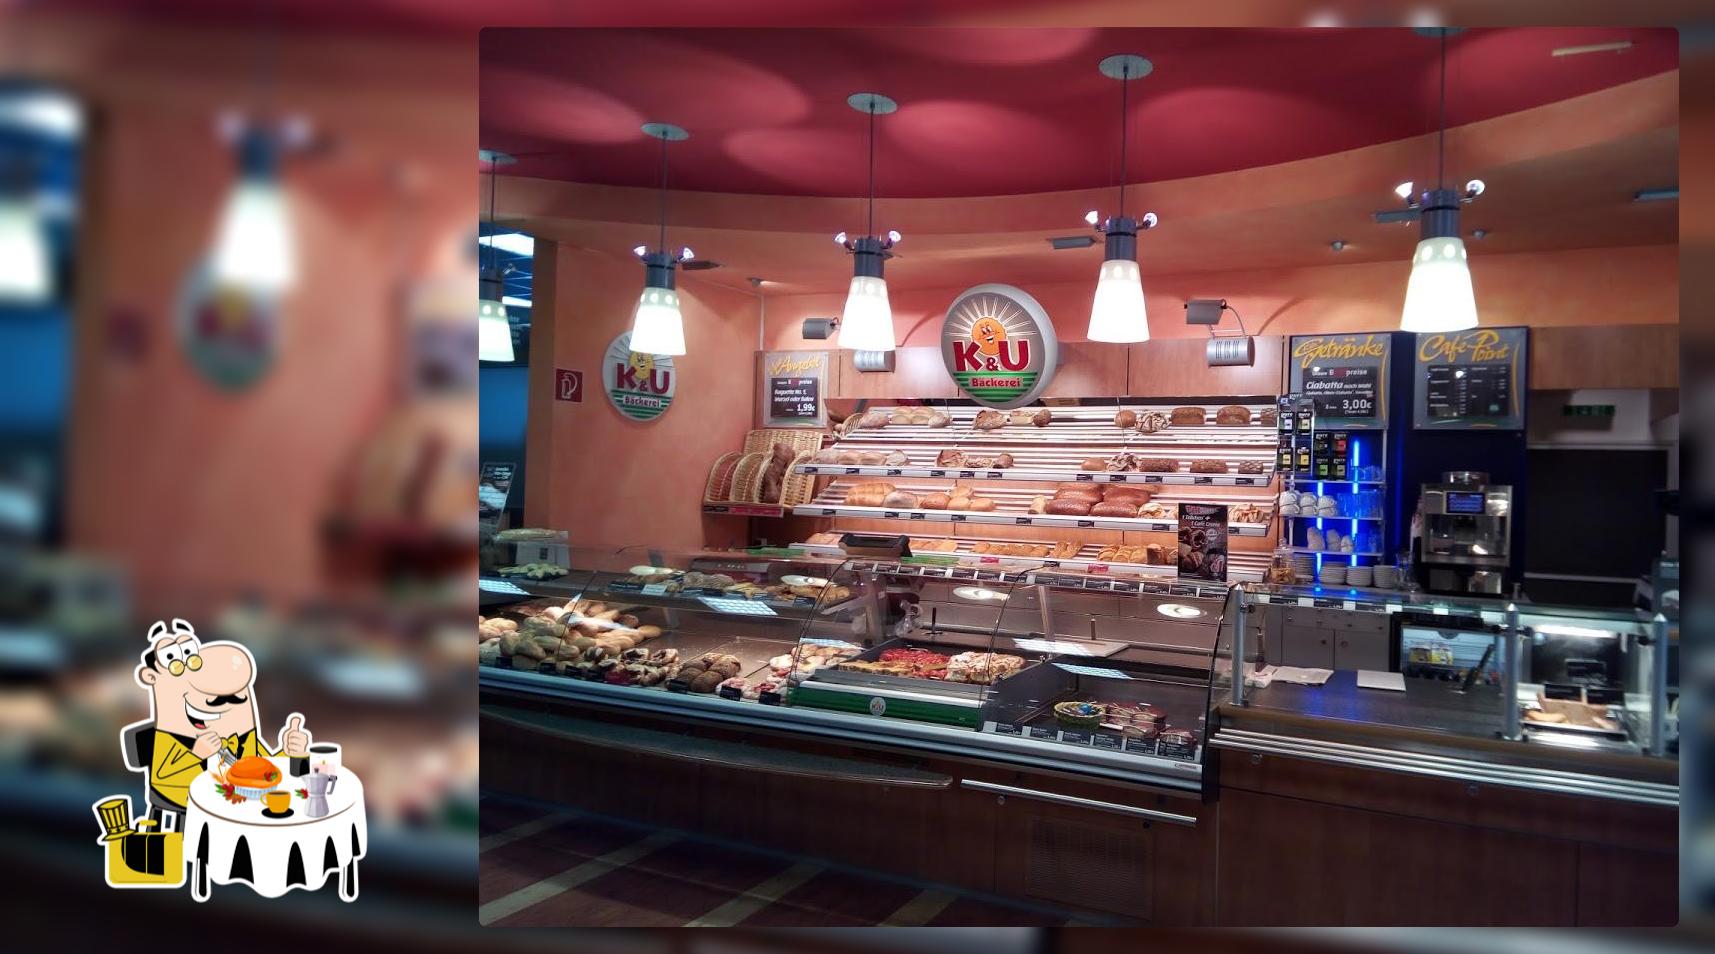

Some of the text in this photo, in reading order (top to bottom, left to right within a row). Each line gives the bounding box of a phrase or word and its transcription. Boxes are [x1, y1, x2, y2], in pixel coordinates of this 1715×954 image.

[1294, 335, 1384, 369] Getränke
[971, 376, 1021, 388] Bäckerei
[1306, 381, 1344, 390] Ciabatta
[625, 396, 660, 408] Bäckerei
